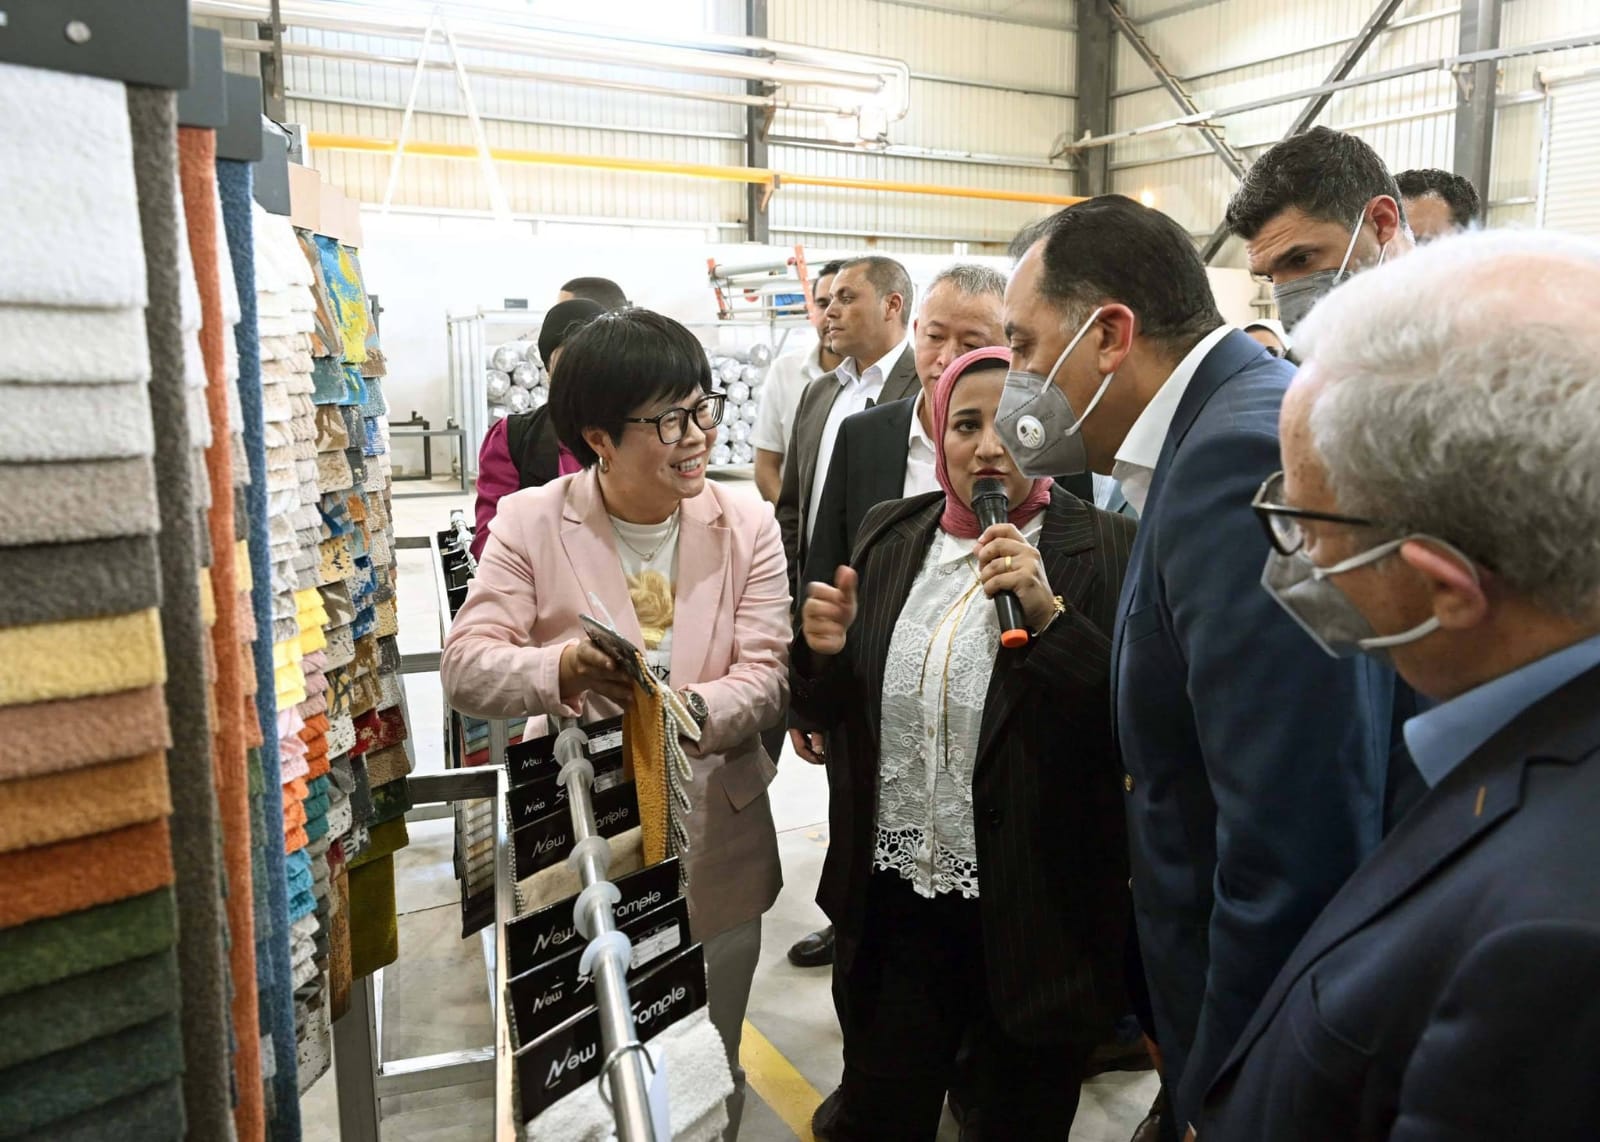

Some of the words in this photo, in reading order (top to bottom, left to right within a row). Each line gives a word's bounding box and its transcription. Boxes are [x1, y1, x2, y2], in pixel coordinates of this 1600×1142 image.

[521, 758, 542, 770] New
[524, 800, 546, 815] New
[532, 833, 565, 858] New
[595, 807, 629, 828] ample
[533, 926, 576, 955] New
[612, 891, 661, 917] ample
[533, 989, 563, 1014] New
[545, 1043, 596, 1087] New
